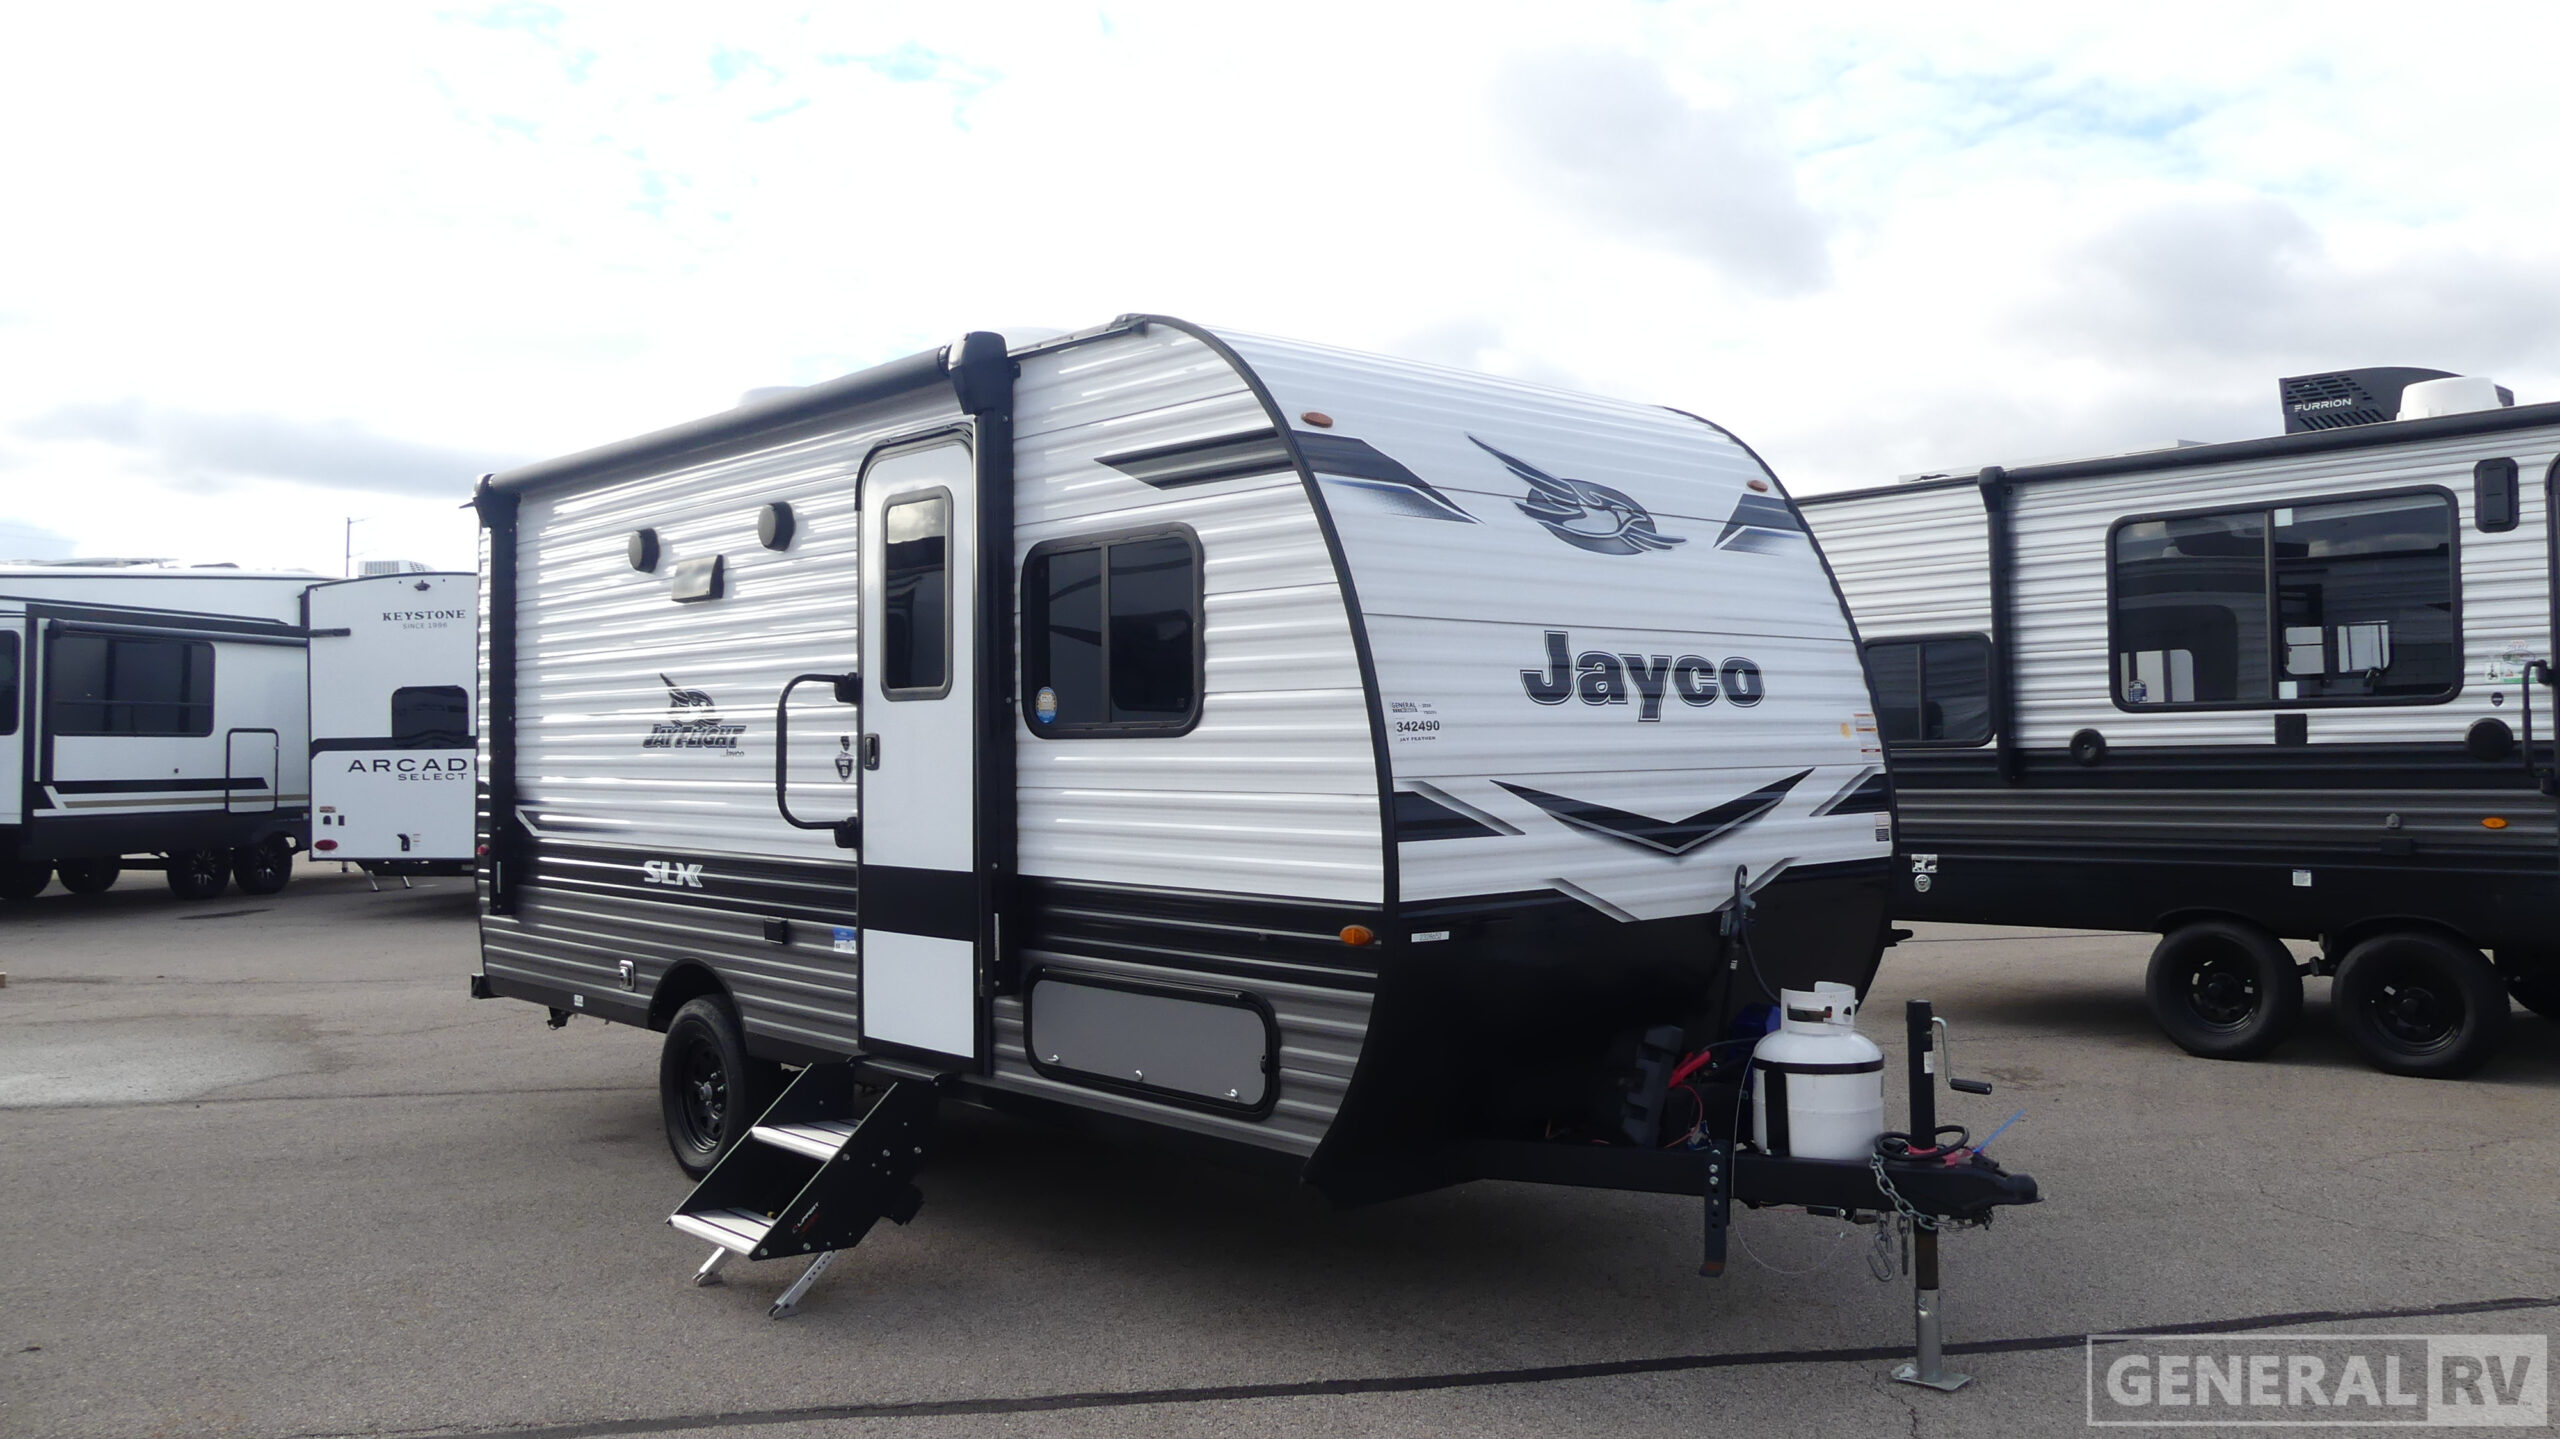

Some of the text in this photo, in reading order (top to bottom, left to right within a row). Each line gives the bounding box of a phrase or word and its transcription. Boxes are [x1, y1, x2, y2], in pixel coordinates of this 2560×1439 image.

[2293, 398, 2352, 412] FURRION
[382, 610, 466, 621] KEYSTONE
[1520, 630, 1765, 722] Jayco
[1396, 720, 1440, 732] 342490
[347, 758, 477, 772] ARCAD
[643, 860, 703, 888] SLX
